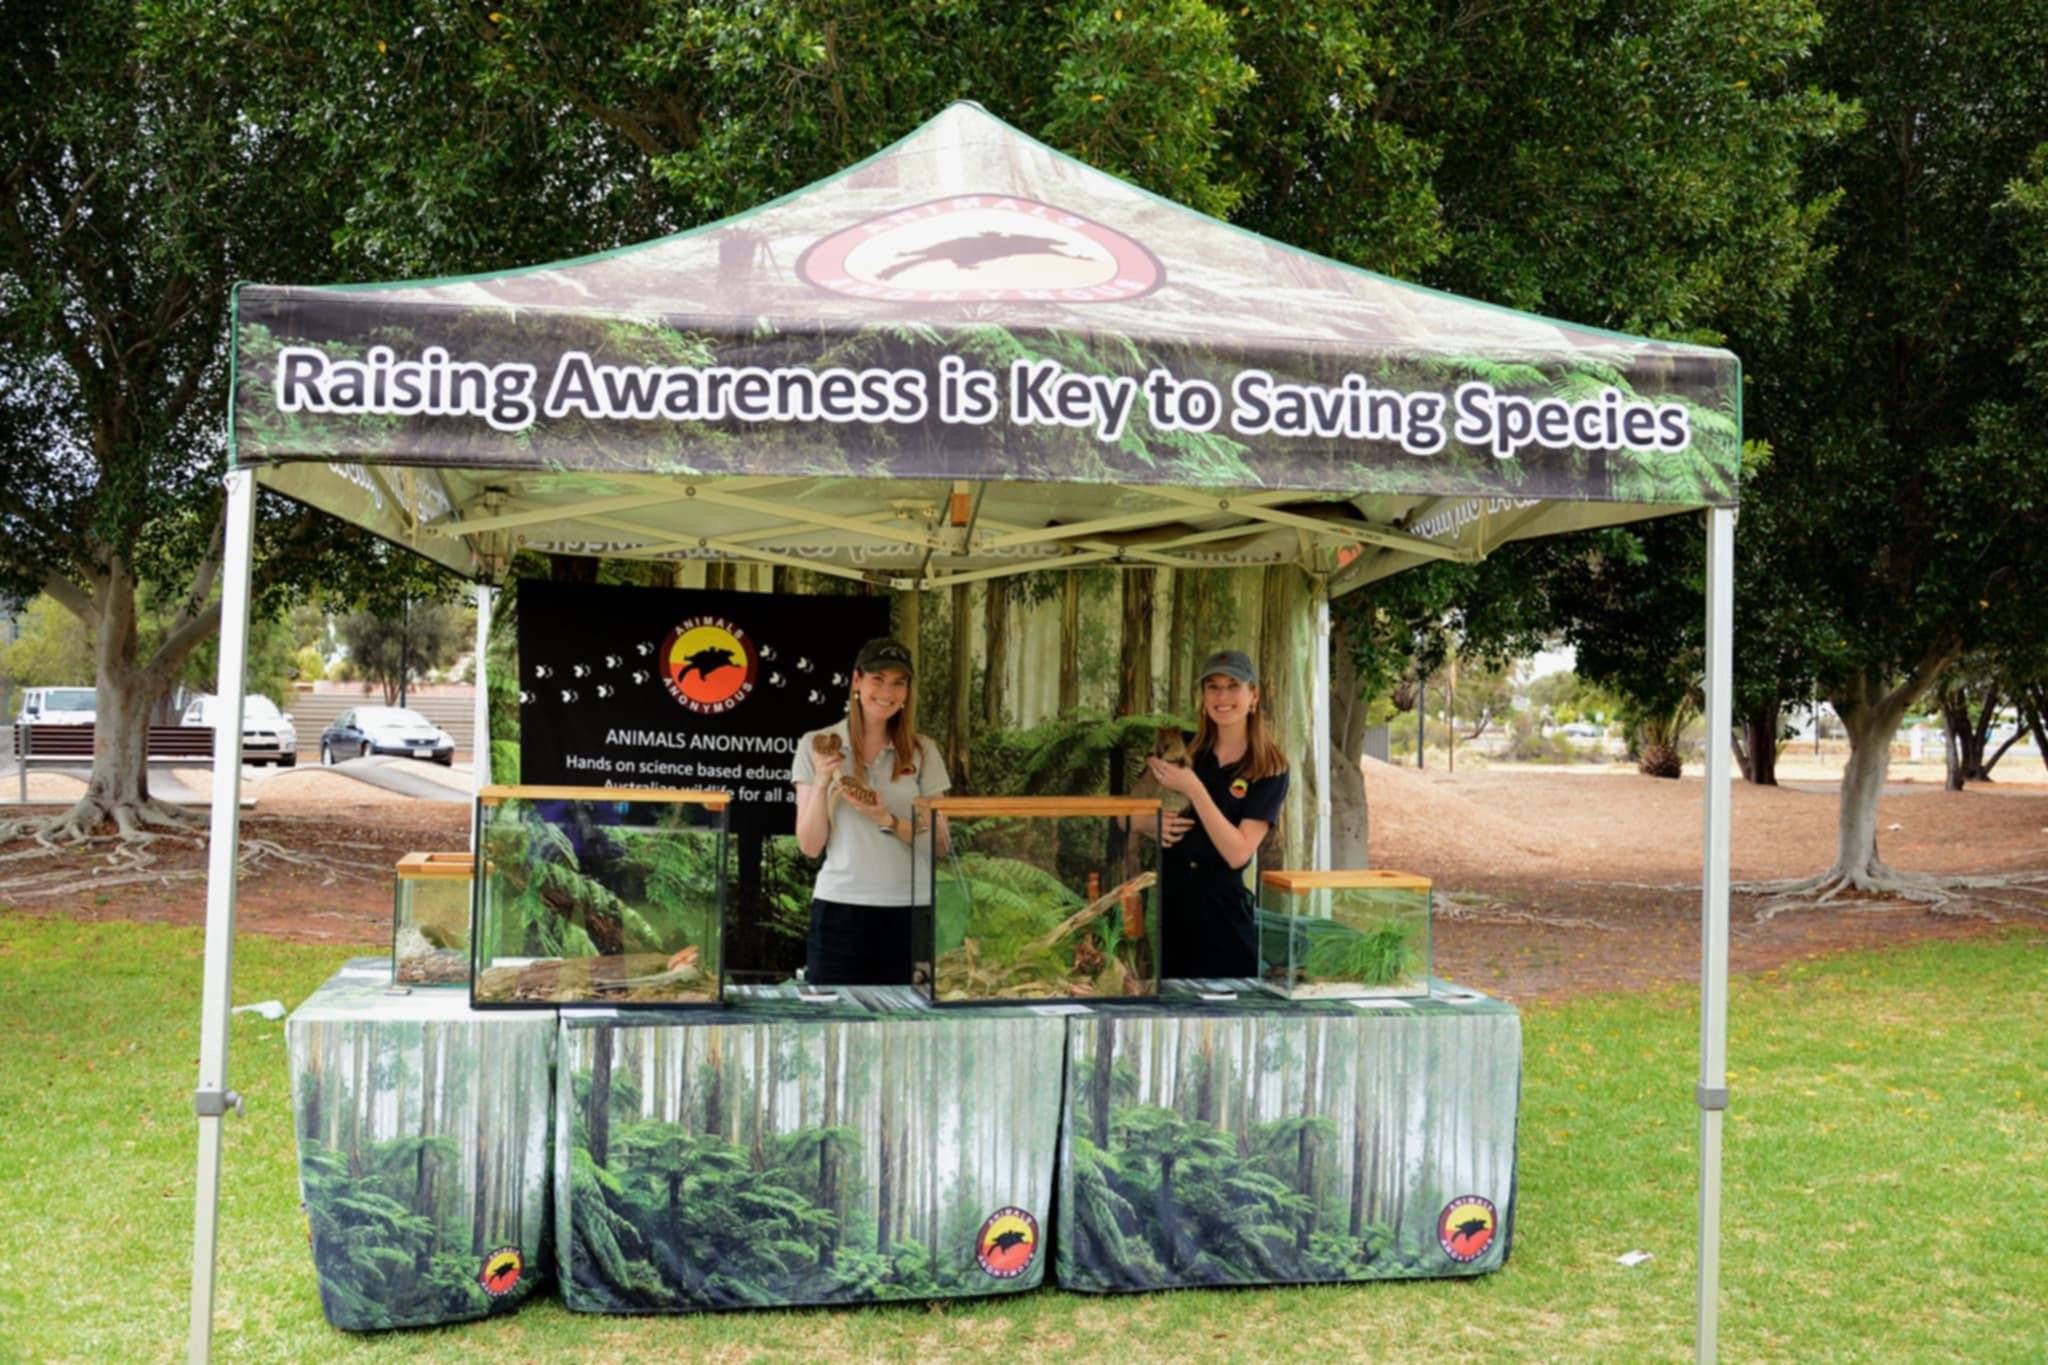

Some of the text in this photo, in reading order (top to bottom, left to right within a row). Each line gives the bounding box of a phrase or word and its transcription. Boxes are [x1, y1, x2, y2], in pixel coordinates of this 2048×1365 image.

[278, 347, 1691, 458] Raising Awareness is Key to Saving Species
[675, 616, 744, 640] ANIMALS
[663, 677, 753, 714] ANONYMOUS
[605, 728, 799, 754] ANIMALS ANONYMOU
[565, 754, 793, 781] Hands on science based educa
[738, 785, 761, 802] for
[764, 787, 783, 803] all
